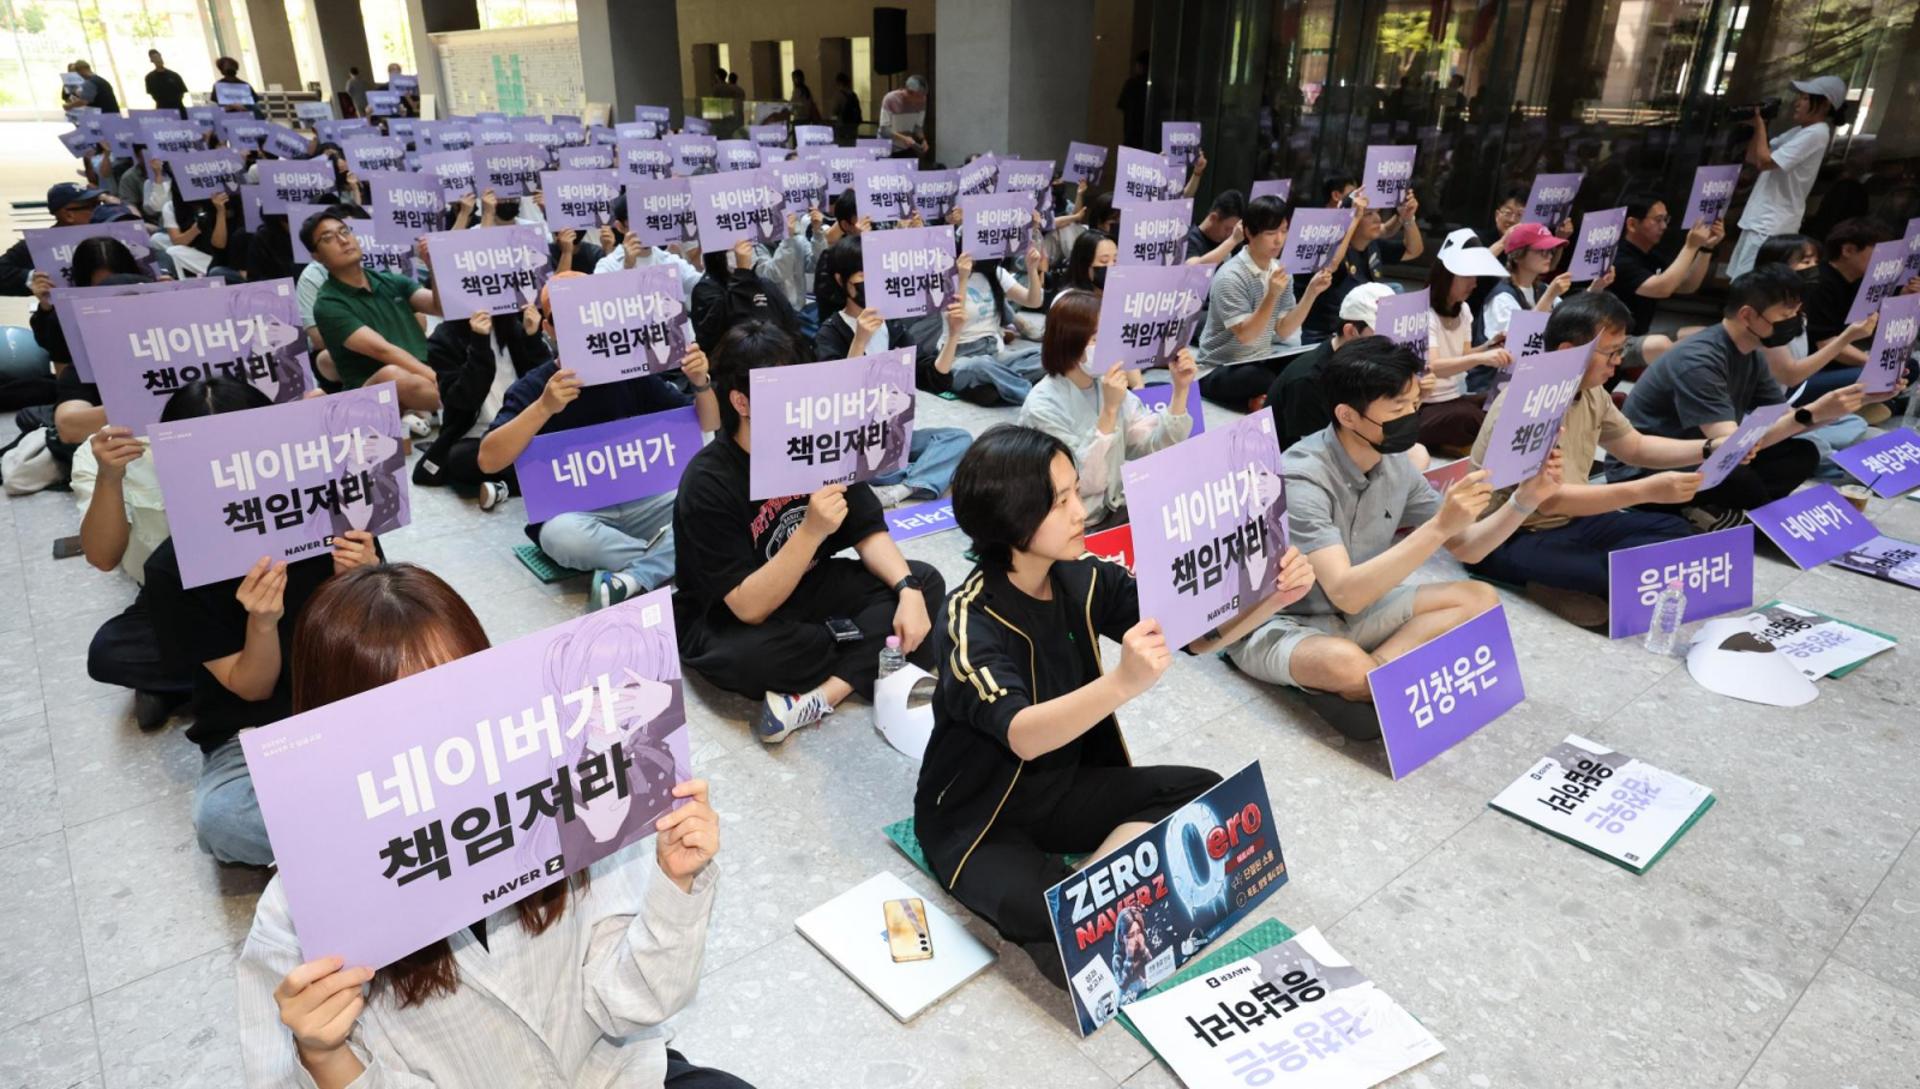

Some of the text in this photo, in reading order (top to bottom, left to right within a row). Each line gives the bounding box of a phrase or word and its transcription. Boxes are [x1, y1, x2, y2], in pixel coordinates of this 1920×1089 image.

[1168, 132, 1197, 144] 네이버가
[354, 147, 394, 158] 네이버가
[486, 155, 536, 171] 네이버가
[570, 155, 605, 168] 네이버가
[627, 149, 666, 162] 네이버가
[1074, 152, 1100, 164] 네이버가
[184, 160, 232, 175] 네이버가
[359, 158, 399, 170] 책임져라
[630, 163, 666, 175] 책임져라
[1126, 163, 1162, 184] 네이버가
[1377, 161, 1412, 176] 네이버가
[191, 171, 236, 188] 책임져라
[273, 172, 323, 188] 네이버가
[490, 172, 538, 186] 책임져라
[868, 174, 908, 191] 네이버가
[917, 181, 953, 196] 네이버가
[1008, 174, 1044, 187] 네이버가
[1126, 181, 1162, 198] 책임져라
[1702, 180, 1734, 198] 네이버가
[388, 188, 438, 208] 네이버가
[558, 183, 610, 200] 네이버가
[711, 186, 769, 211] 네이버가
[870, 192, 910, 207] 책임져라
[916, 194, 950, 209] 책임져라
[1538, 187, 1572, 201] 네이버가
[561, 200, 610, 216] 책임져라
[976, 208, 1022, 226] 네이버가
[646, 210, 697, 231] 책임져라
[716, 207, 773, 232] 책임져라
[1134, 218, 1180, 238] 네이버가
[978, 228, 1022, 246] 책임져라
[1300, 224, 1342, 242] 네이버가
[1587, 224, 1616, 246] 네이버가
[361, 252, 402, 268] 임져라
[454, 245, 531, 272] 네이버가
[882, 247, 942, 273] 네이버가
[1134, 240, 1178, 261] 책임져라
[1296, 244, 1334, 260] 책임져라
[1873, 258, 1903, 280] 네이버가
[462, 269, 536, 297] 책임져라
[885, 272, 944, 298] 책임져라
[579, 291, 664, 328] 네이버가
[1124, 288, 1191, 318] 네이버가
[130, 314, 268, 362] 네이버가
[586, 320, 670, 358] 책임져라
[1121, 319, 1184, 349] 책임져라
[1884, 316, 1915, 344] 네이버가
[621, 366, 642, 374] NAVER
[785, 384, 890, 432] 네이버가
[786, 420, 890, 466] 책임져라
[210, 426, 367, 492] 네이버가
[551, 432, 676, 488] 네이버가
[1861, 441, 1920, 474] 책임져라
[223, 470, 374, 536] 책임져라
[1162, 462, 1262, 543] 네이버가
[1780, 502, 1852, 543] 네이버가
[284, 540, 320, 556] NAVER
[1170, 515, 1268, 597] 책임져라
[1206, 601, 1230, 622] NAVER
[1778, 630, 1851, 658] 김창욱은
[1405, 644, 1498, 728] 김창욱은
[356, 672, 621, 820] 네이버가
[1537, 758, 1614, 815] 응답하라
[378, 742, 633, 887] 책임져라
[1584, 778, 1662, 834] 김창욱은
[482, 856, 564, 904] NAVER Z
[1065, 840, 1159, 925] ZERO
[1075, 873, 1169, 950] NAVER Z
[1221, 966, 1252, 982] NAVER
[1184, 970, 1326, 1048] 응답하라
[1225, 1006, 1374, 1087] 김창욱은
